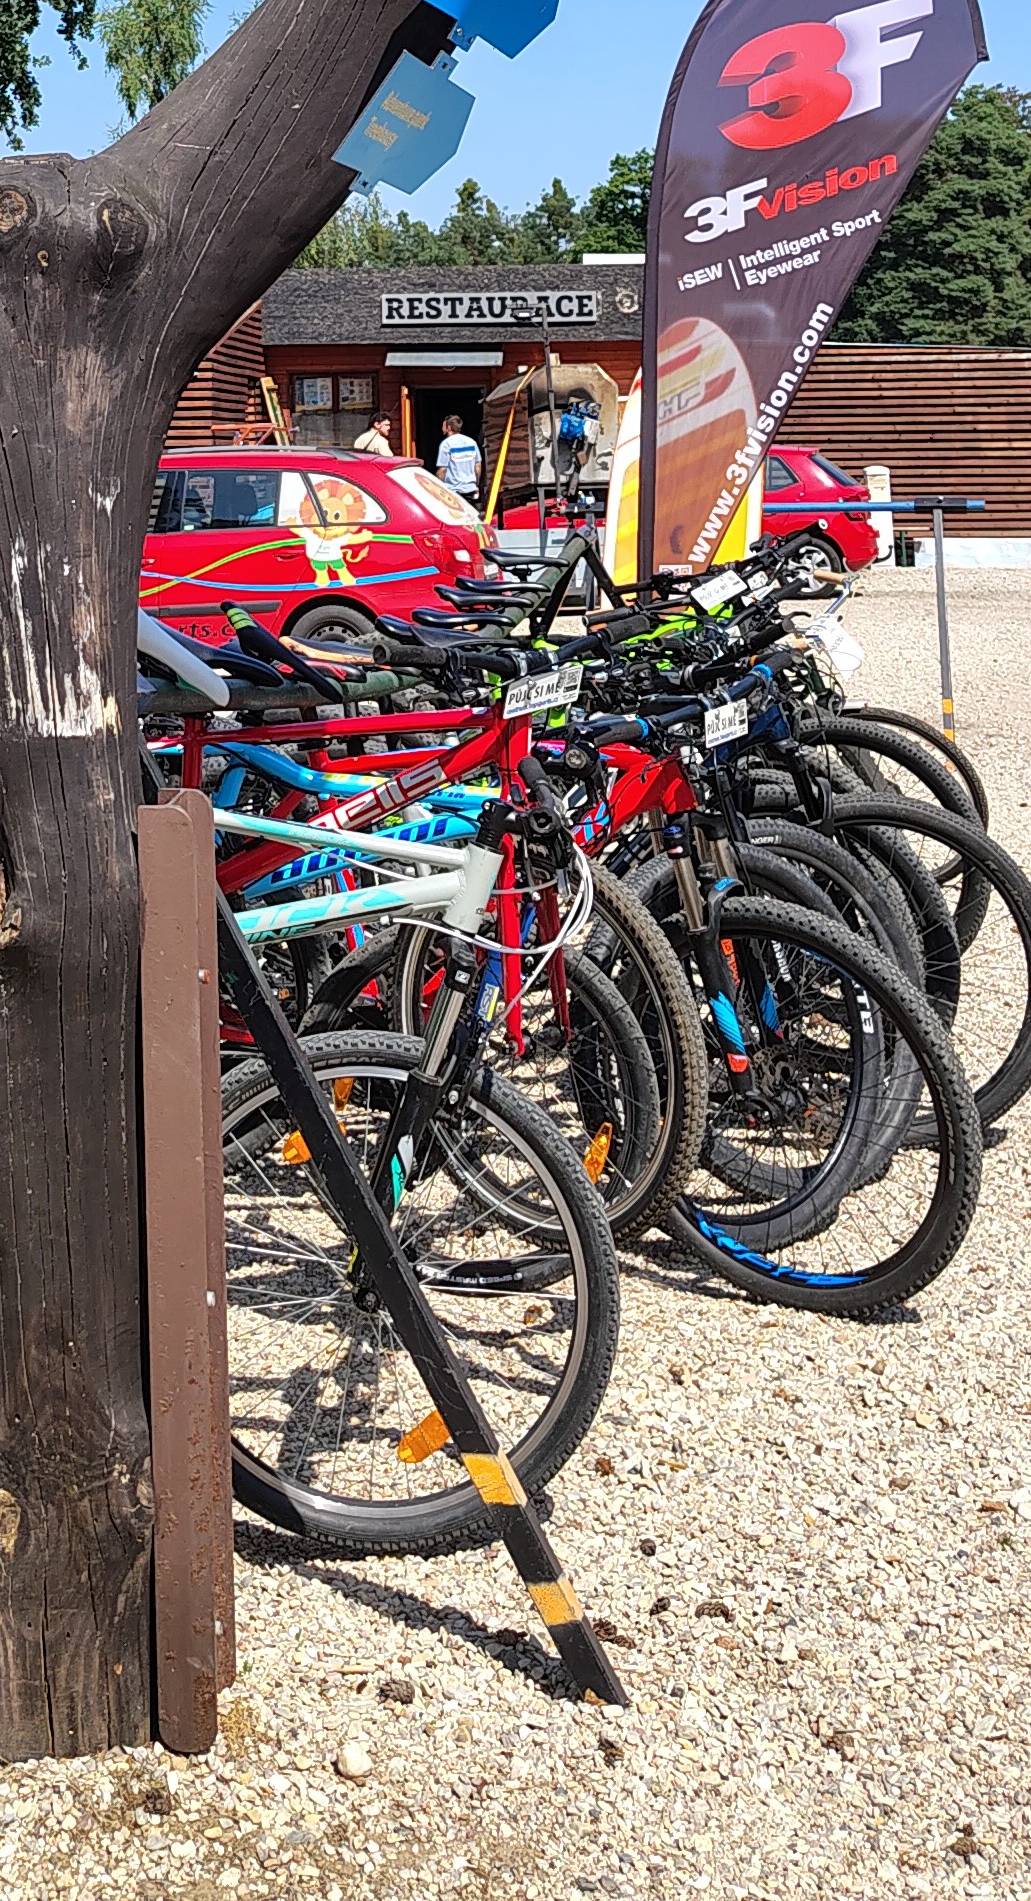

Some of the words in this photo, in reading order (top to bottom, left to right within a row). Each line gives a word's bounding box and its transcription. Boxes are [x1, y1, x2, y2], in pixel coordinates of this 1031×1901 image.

[676, 262, 723, 292] iSEW
[738, 226, 830, 271] Intelligent
[831, 209, 883, 238] Sport
[744, 249, 821, 288] Eyewear
[687, 301, 835, 565] www.3fvision.com
